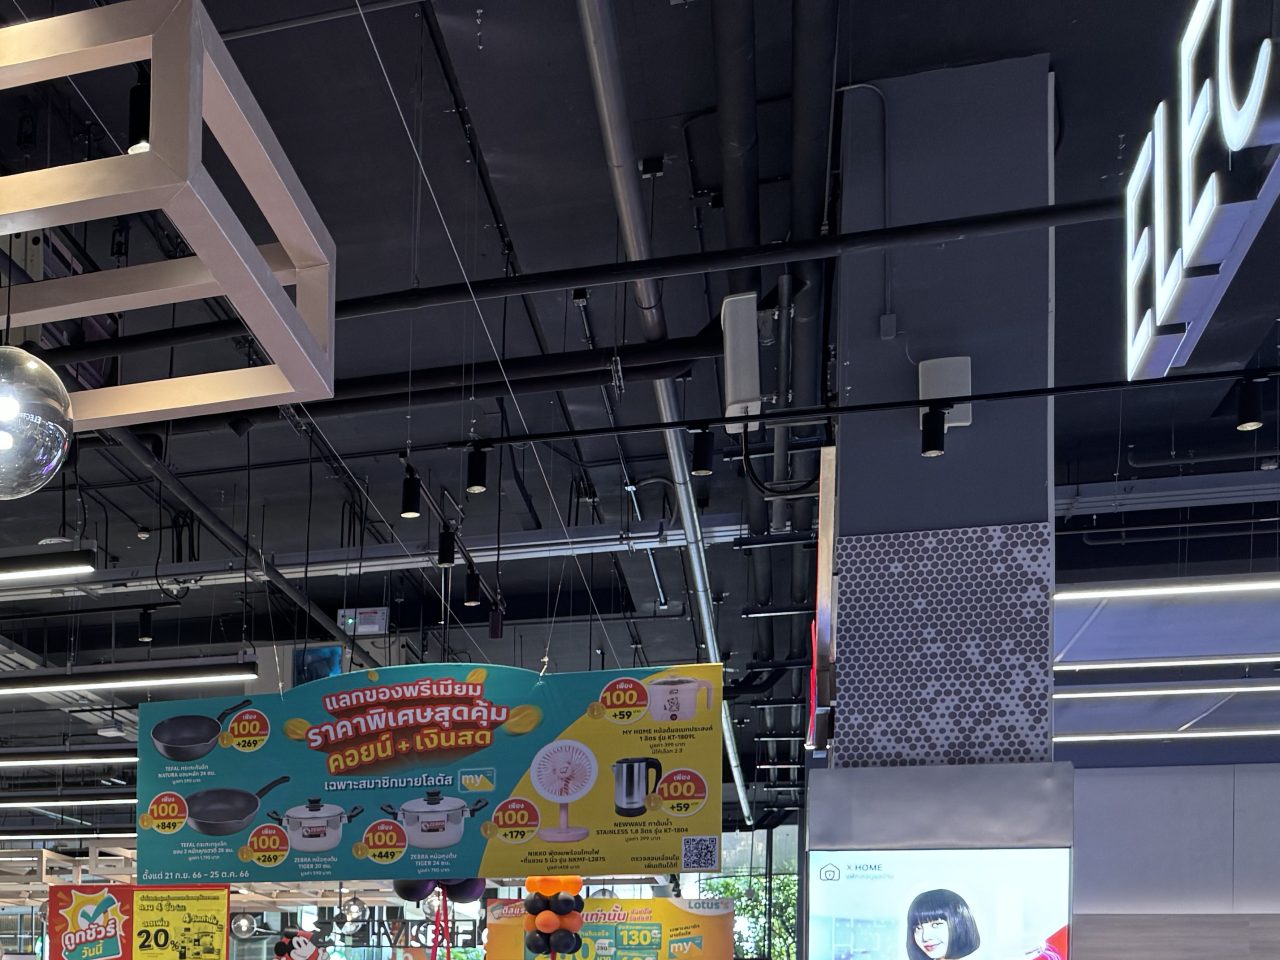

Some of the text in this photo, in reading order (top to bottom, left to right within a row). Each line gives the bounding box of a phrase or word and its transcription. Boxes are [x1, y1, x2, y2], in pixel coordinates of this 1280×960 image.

[325, 678, 482, 711] แลกของพรีเมียม
[602, 690, 638, 706] 100
[612, 710, 633, 720] +59
[230, 721, 261, 735] 100
[307, 700, 508, 748] ราคาพิเศษสุดคุ้ม
[236, 739, 258, 749] +269
[328, 729, 492, 773] คอยน์ + เงินสด
[324, 773, 453, 791] เฉพาะสมาชิกมายโลตัส
[461, 774, 482, 786] my
[659, 782, 696, 798] 100
[151, 803, 179, 817] 100
[670, 802, 690, 812] +59
[495, 810, 529, 826] 100
[155, 821, 177, 830] +849
[366, 832, 397, 846] 100
[502, 830, 526, 839] +179
[250, 836, 280, 850] 100
[256, 854, 278, 862] +269
[371, 850, 396, 859] +449
[192, 871, 202, 879] 66
[64, 919, 117, 951] ถูกชัวร์
[620, 929, 651, 945] 130
[82, 939, 104, 959] วันนี้
[670, 941, 692, 953] my
